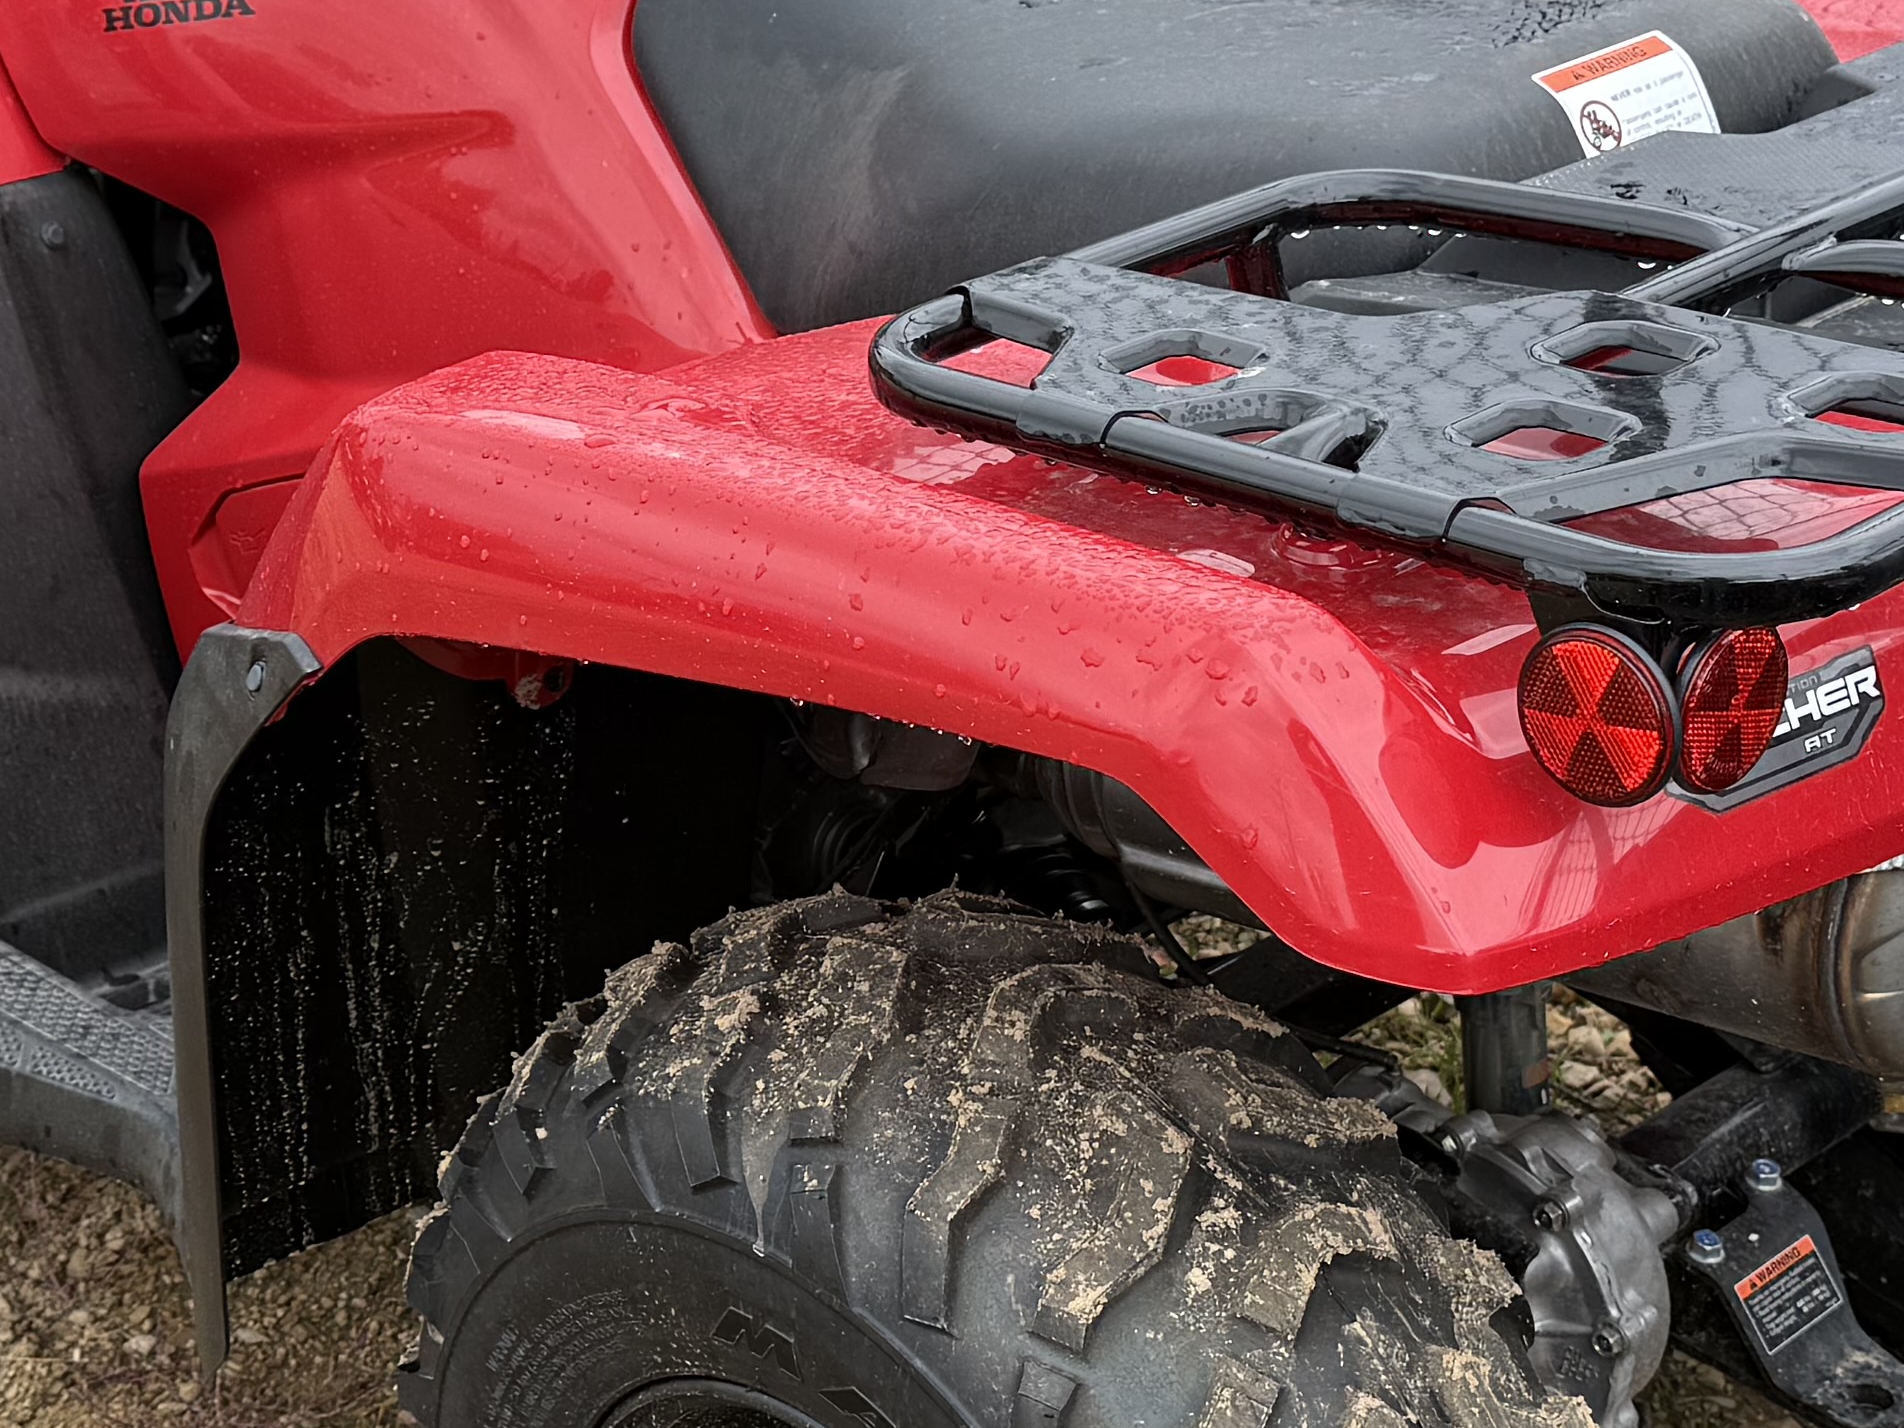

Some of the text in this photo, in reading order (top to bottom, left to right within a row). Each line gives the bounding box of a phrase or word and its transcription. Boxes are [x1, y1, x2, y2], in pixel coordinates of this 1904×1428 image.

[1581, 45, 1648, 75] WARNING
[1772, 665, 1881, 738] HER
[1804, 727, 1837, 753] AT
[1755, 1245, 1802, 1283] WARNING
